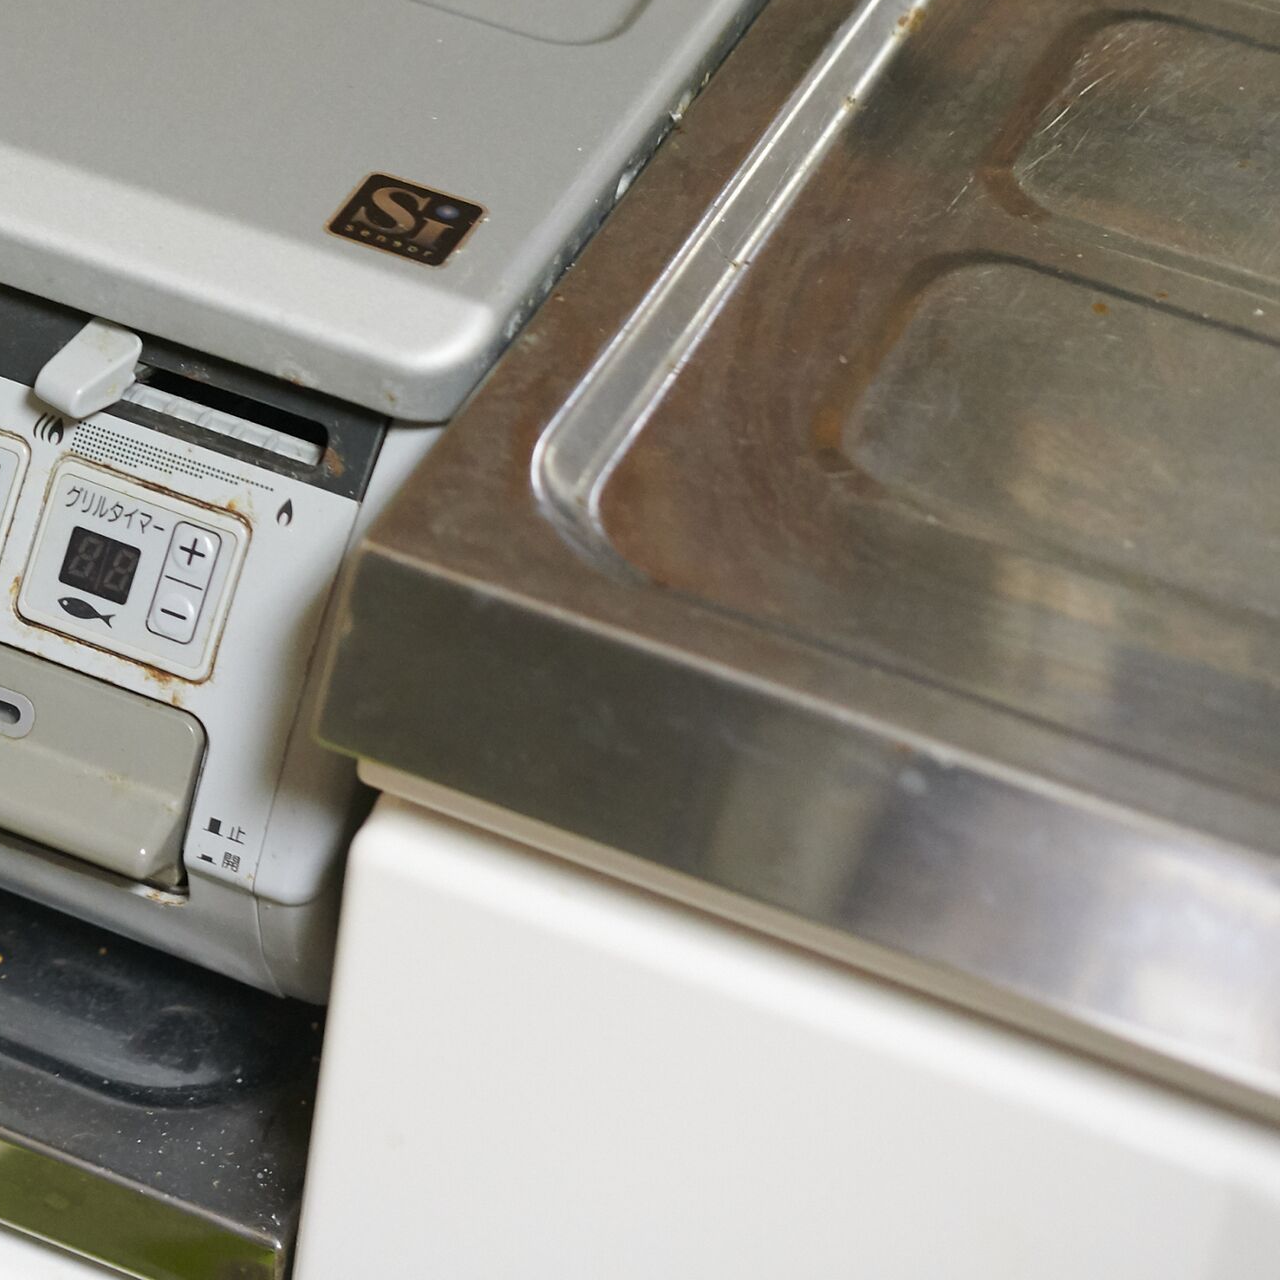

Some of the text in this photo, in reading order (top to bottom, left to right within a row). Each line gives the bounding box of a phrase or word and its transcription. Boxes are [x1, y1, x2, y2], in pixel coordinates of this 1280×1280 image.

[344, 223, 434, 258] sensor
[65, 485, 165, 534] グリルタイマー
[226, 825, 247, 846] 止
[221, 850, 242, 873] 開
